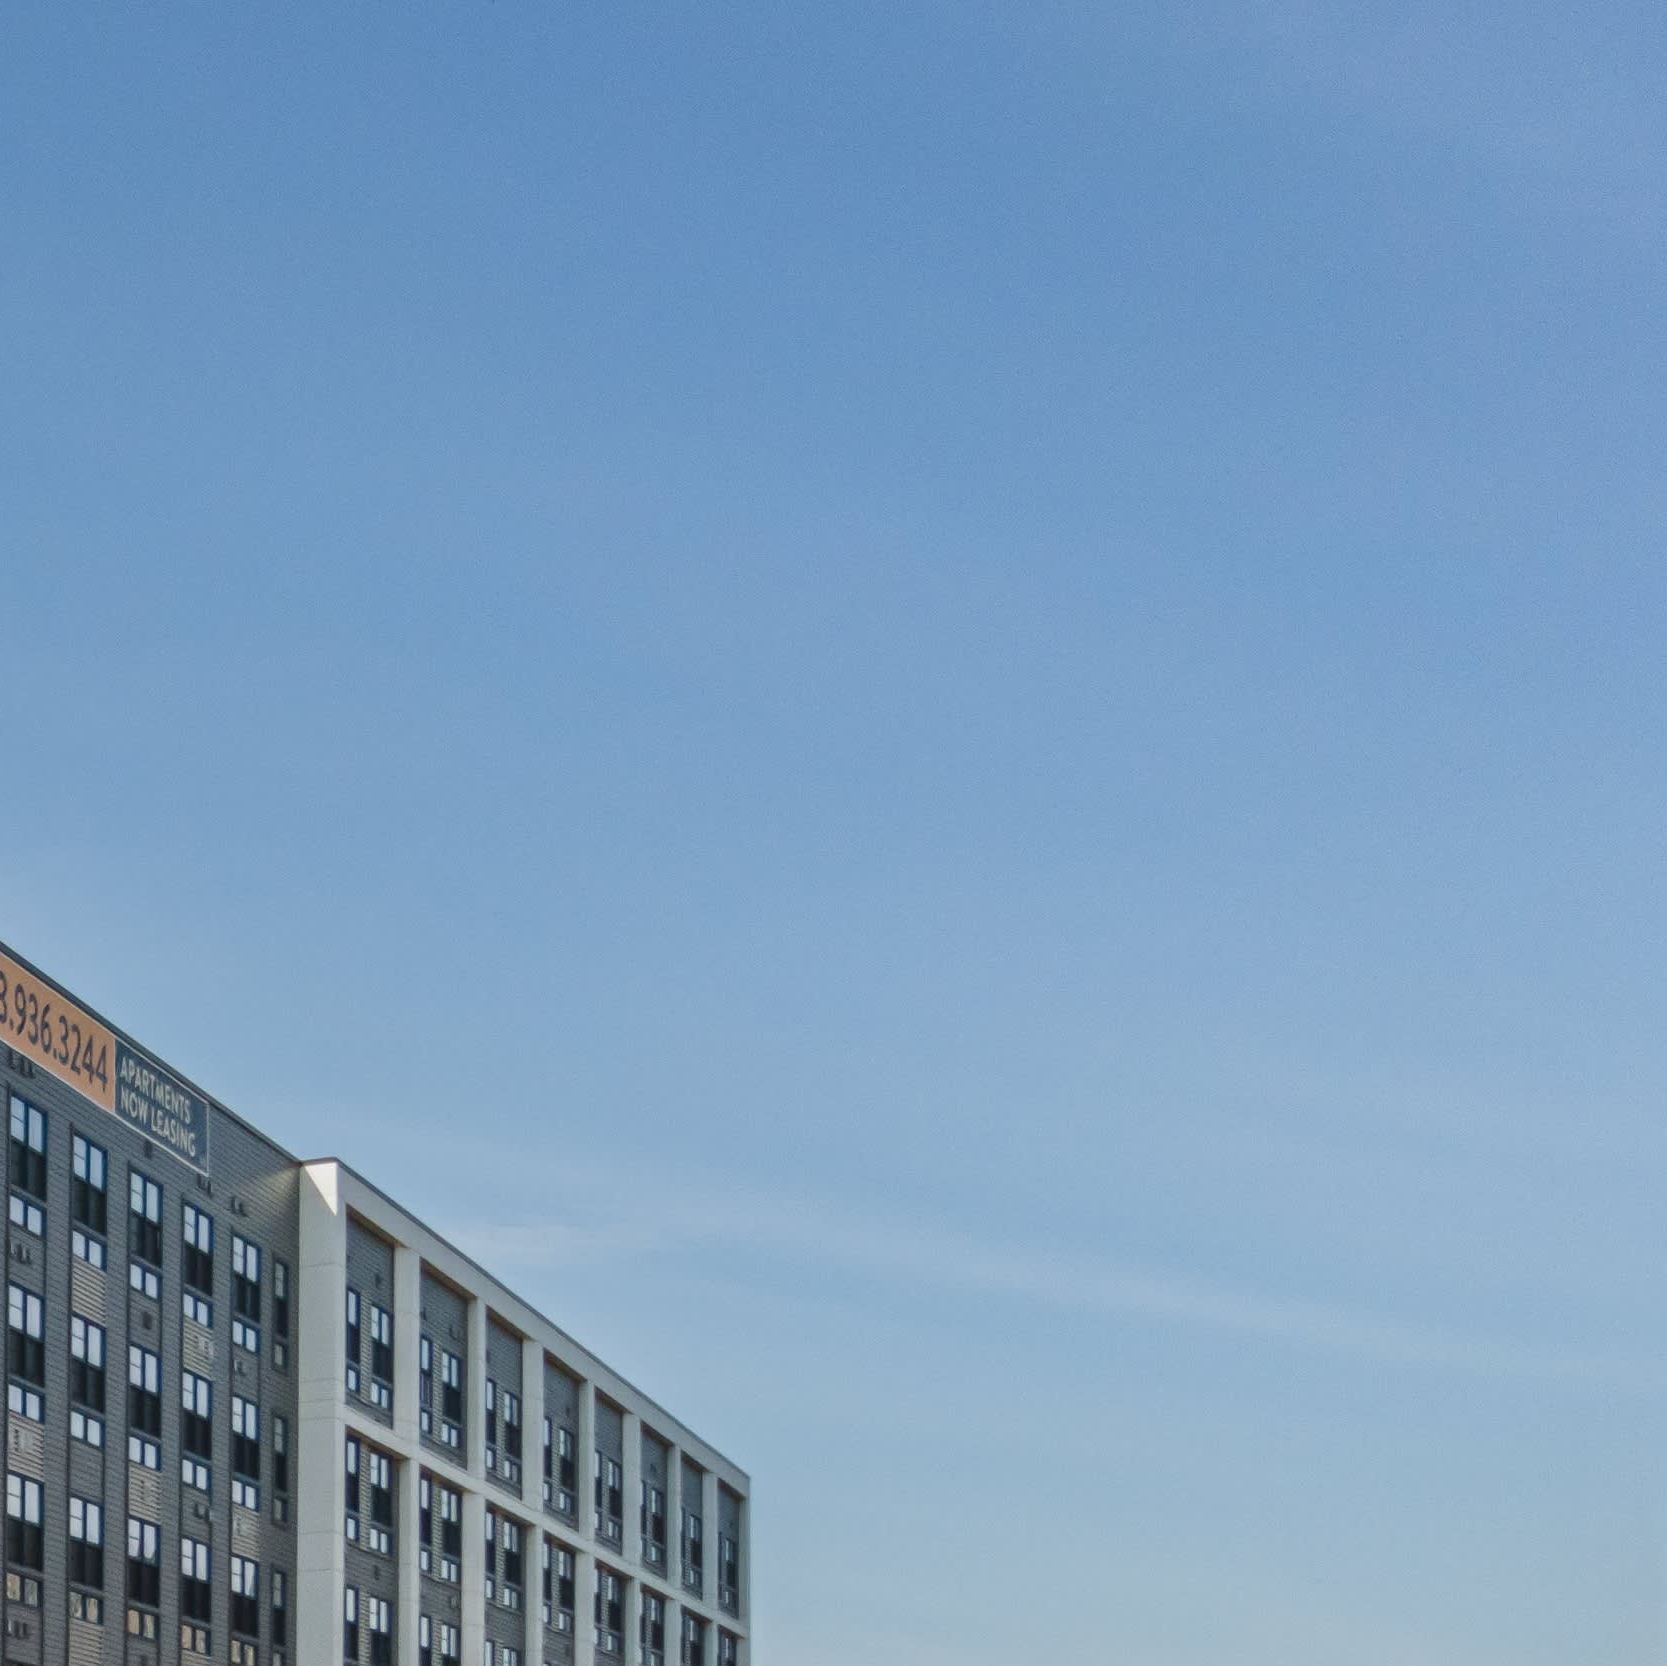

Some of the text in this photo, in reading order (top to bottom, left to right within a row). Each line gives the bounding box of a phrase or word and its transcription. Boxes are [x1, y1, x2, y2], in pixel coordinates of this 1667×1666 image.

[119, 1056, 191, 1125] APARTMENTS
[121, 1084, 196, 1158] NOW LEASING
